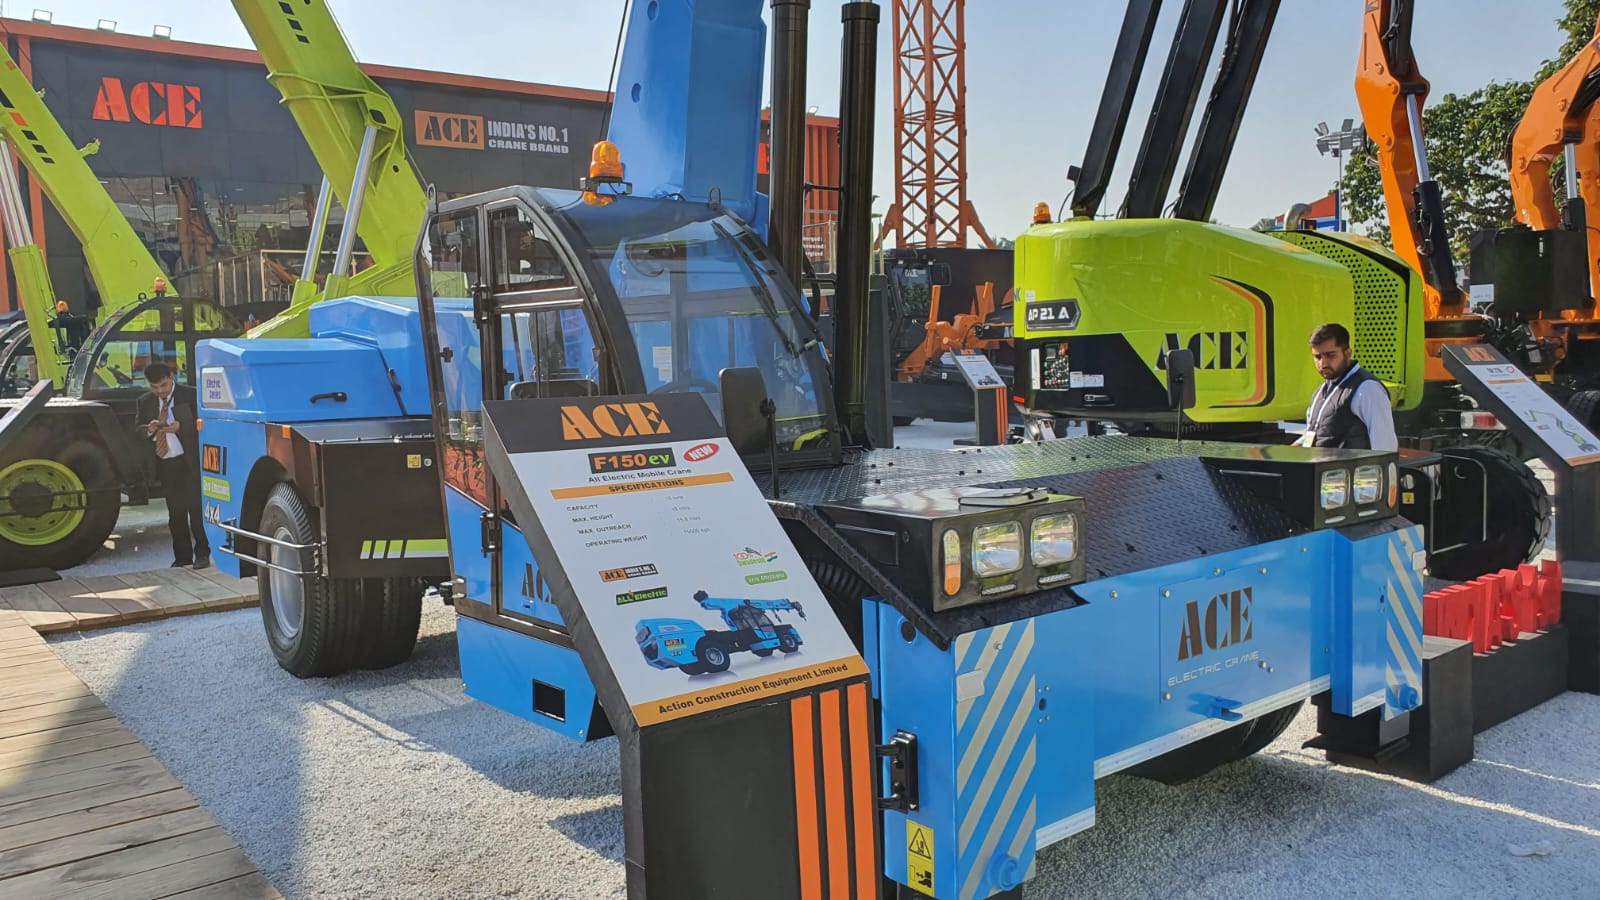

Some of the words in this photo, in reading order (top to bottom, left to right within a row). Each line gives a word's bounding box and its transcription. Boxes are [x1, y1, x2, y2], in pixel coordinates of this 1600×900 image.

[92, 77, 202, 128] ACE
[424, 116, 478, 144] ACE
[488, 121, 536, 139] INDIA'S
[538, 125, 560, 142] NO.
[562, 128, 569, 143] 1
[489, 139, 528, 150] CRANE
[530, 142, 569, 154] BRAND
[1028, 308, 1039, 321] AP
[1040, 307, 1055, 320] 21
[1058, 306, 1070, 319] A
[1154, 332, 1247, 369] ACE
[561, 402, 671, 440] ACE
[688, 445, 715, 460] NEW
[593, 453, 670, 471] F150ev
[603, 473, 636, 482] Electric
[637, 470, 667, 478] Mobile
[608, 480, 684, 492] SPECIFICATIONS
[566, 504, 598, 512] CAPACITY
[590, 513, 613, 521] HEIGHT
[596, 524, 632, 533] OUTREACH
[585, 537, 623, 548] OPERATING
[623, 534, 648, 543] WEIGHT
[1177, 586, 1253, 662] ACE
[1167, 662, 1222, 688] ELECTRIC
[1224, 650, 1260, 668] CRANE
[658, 699, 694, 714] Action
[696, 684, 761, 705] Construction
[762, 673, 813, 690] Equipment
[815, 663, 848, 678] Limited
